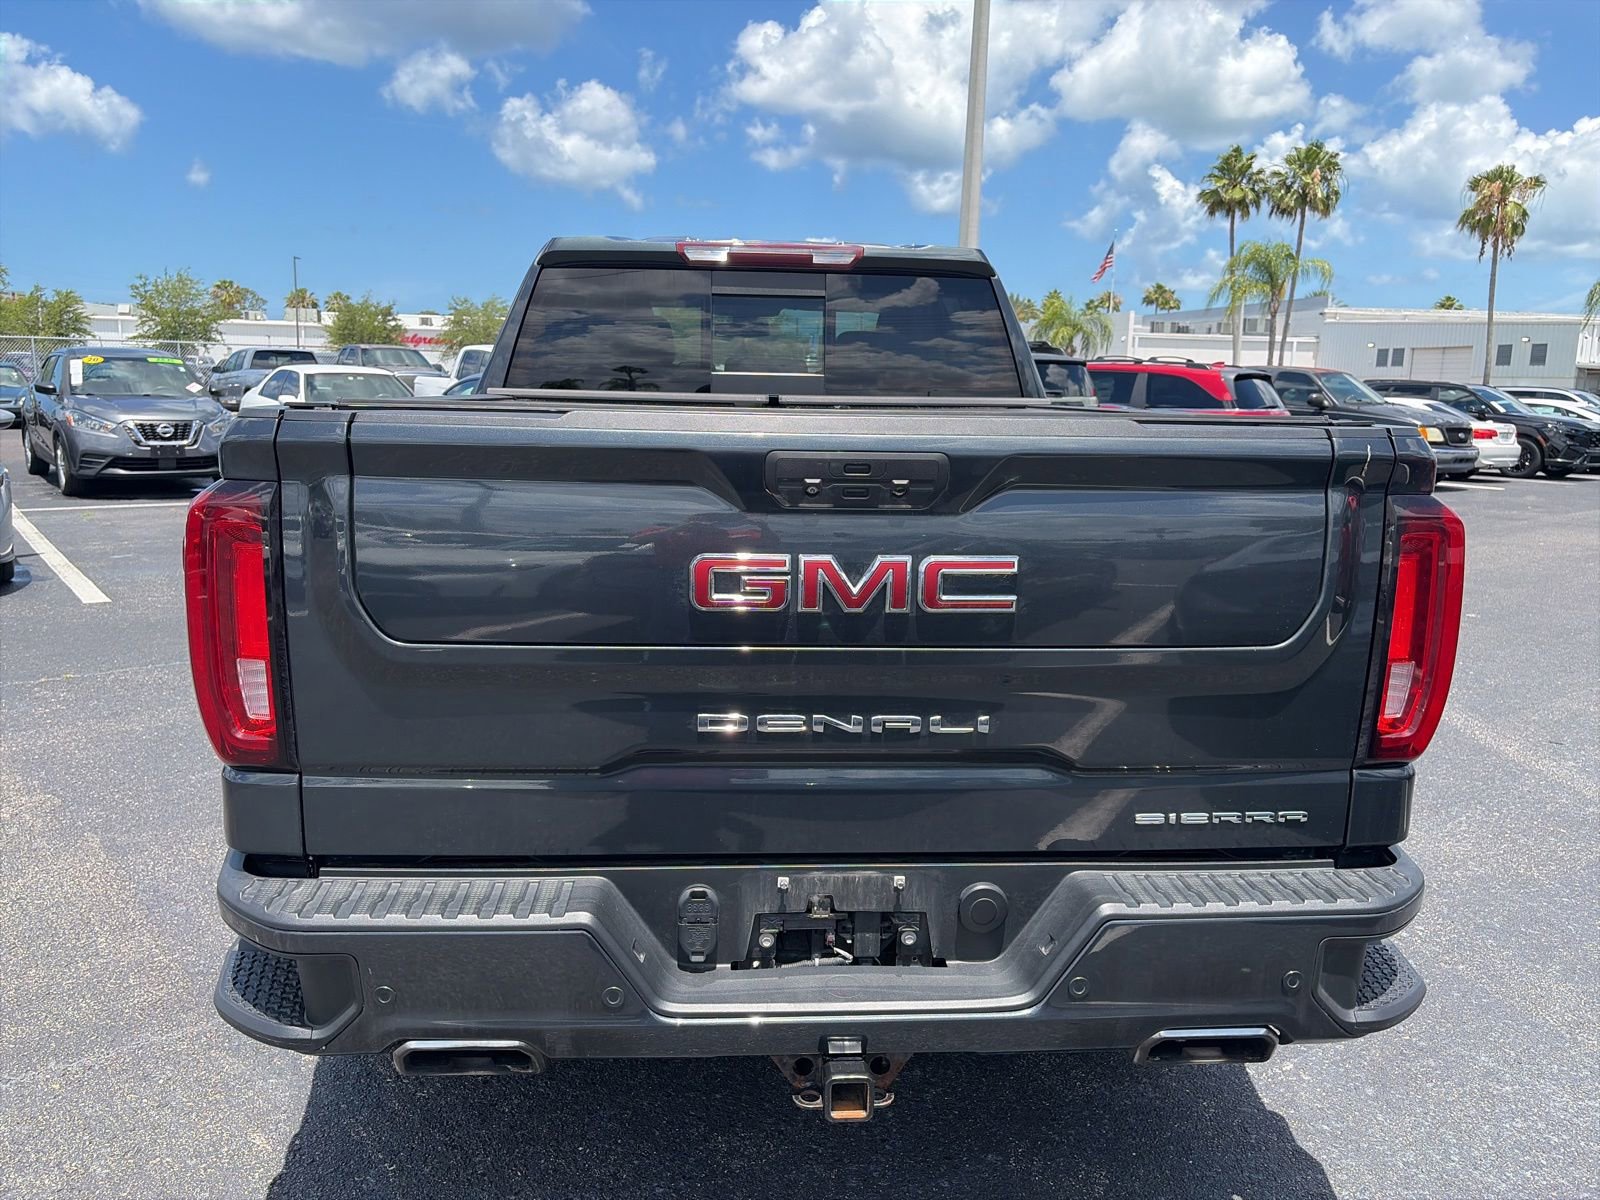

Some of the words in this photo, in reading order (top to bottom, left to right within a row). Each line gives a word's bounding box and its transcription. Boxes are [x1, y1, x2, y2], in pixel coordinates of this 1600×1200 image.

[395, 332, 455, 348] algreens
[689, 552, 1020, 614] GMC
[697, 713, 990, 734] DENALI
[1134, 810, 1309, 825] SIERRA
